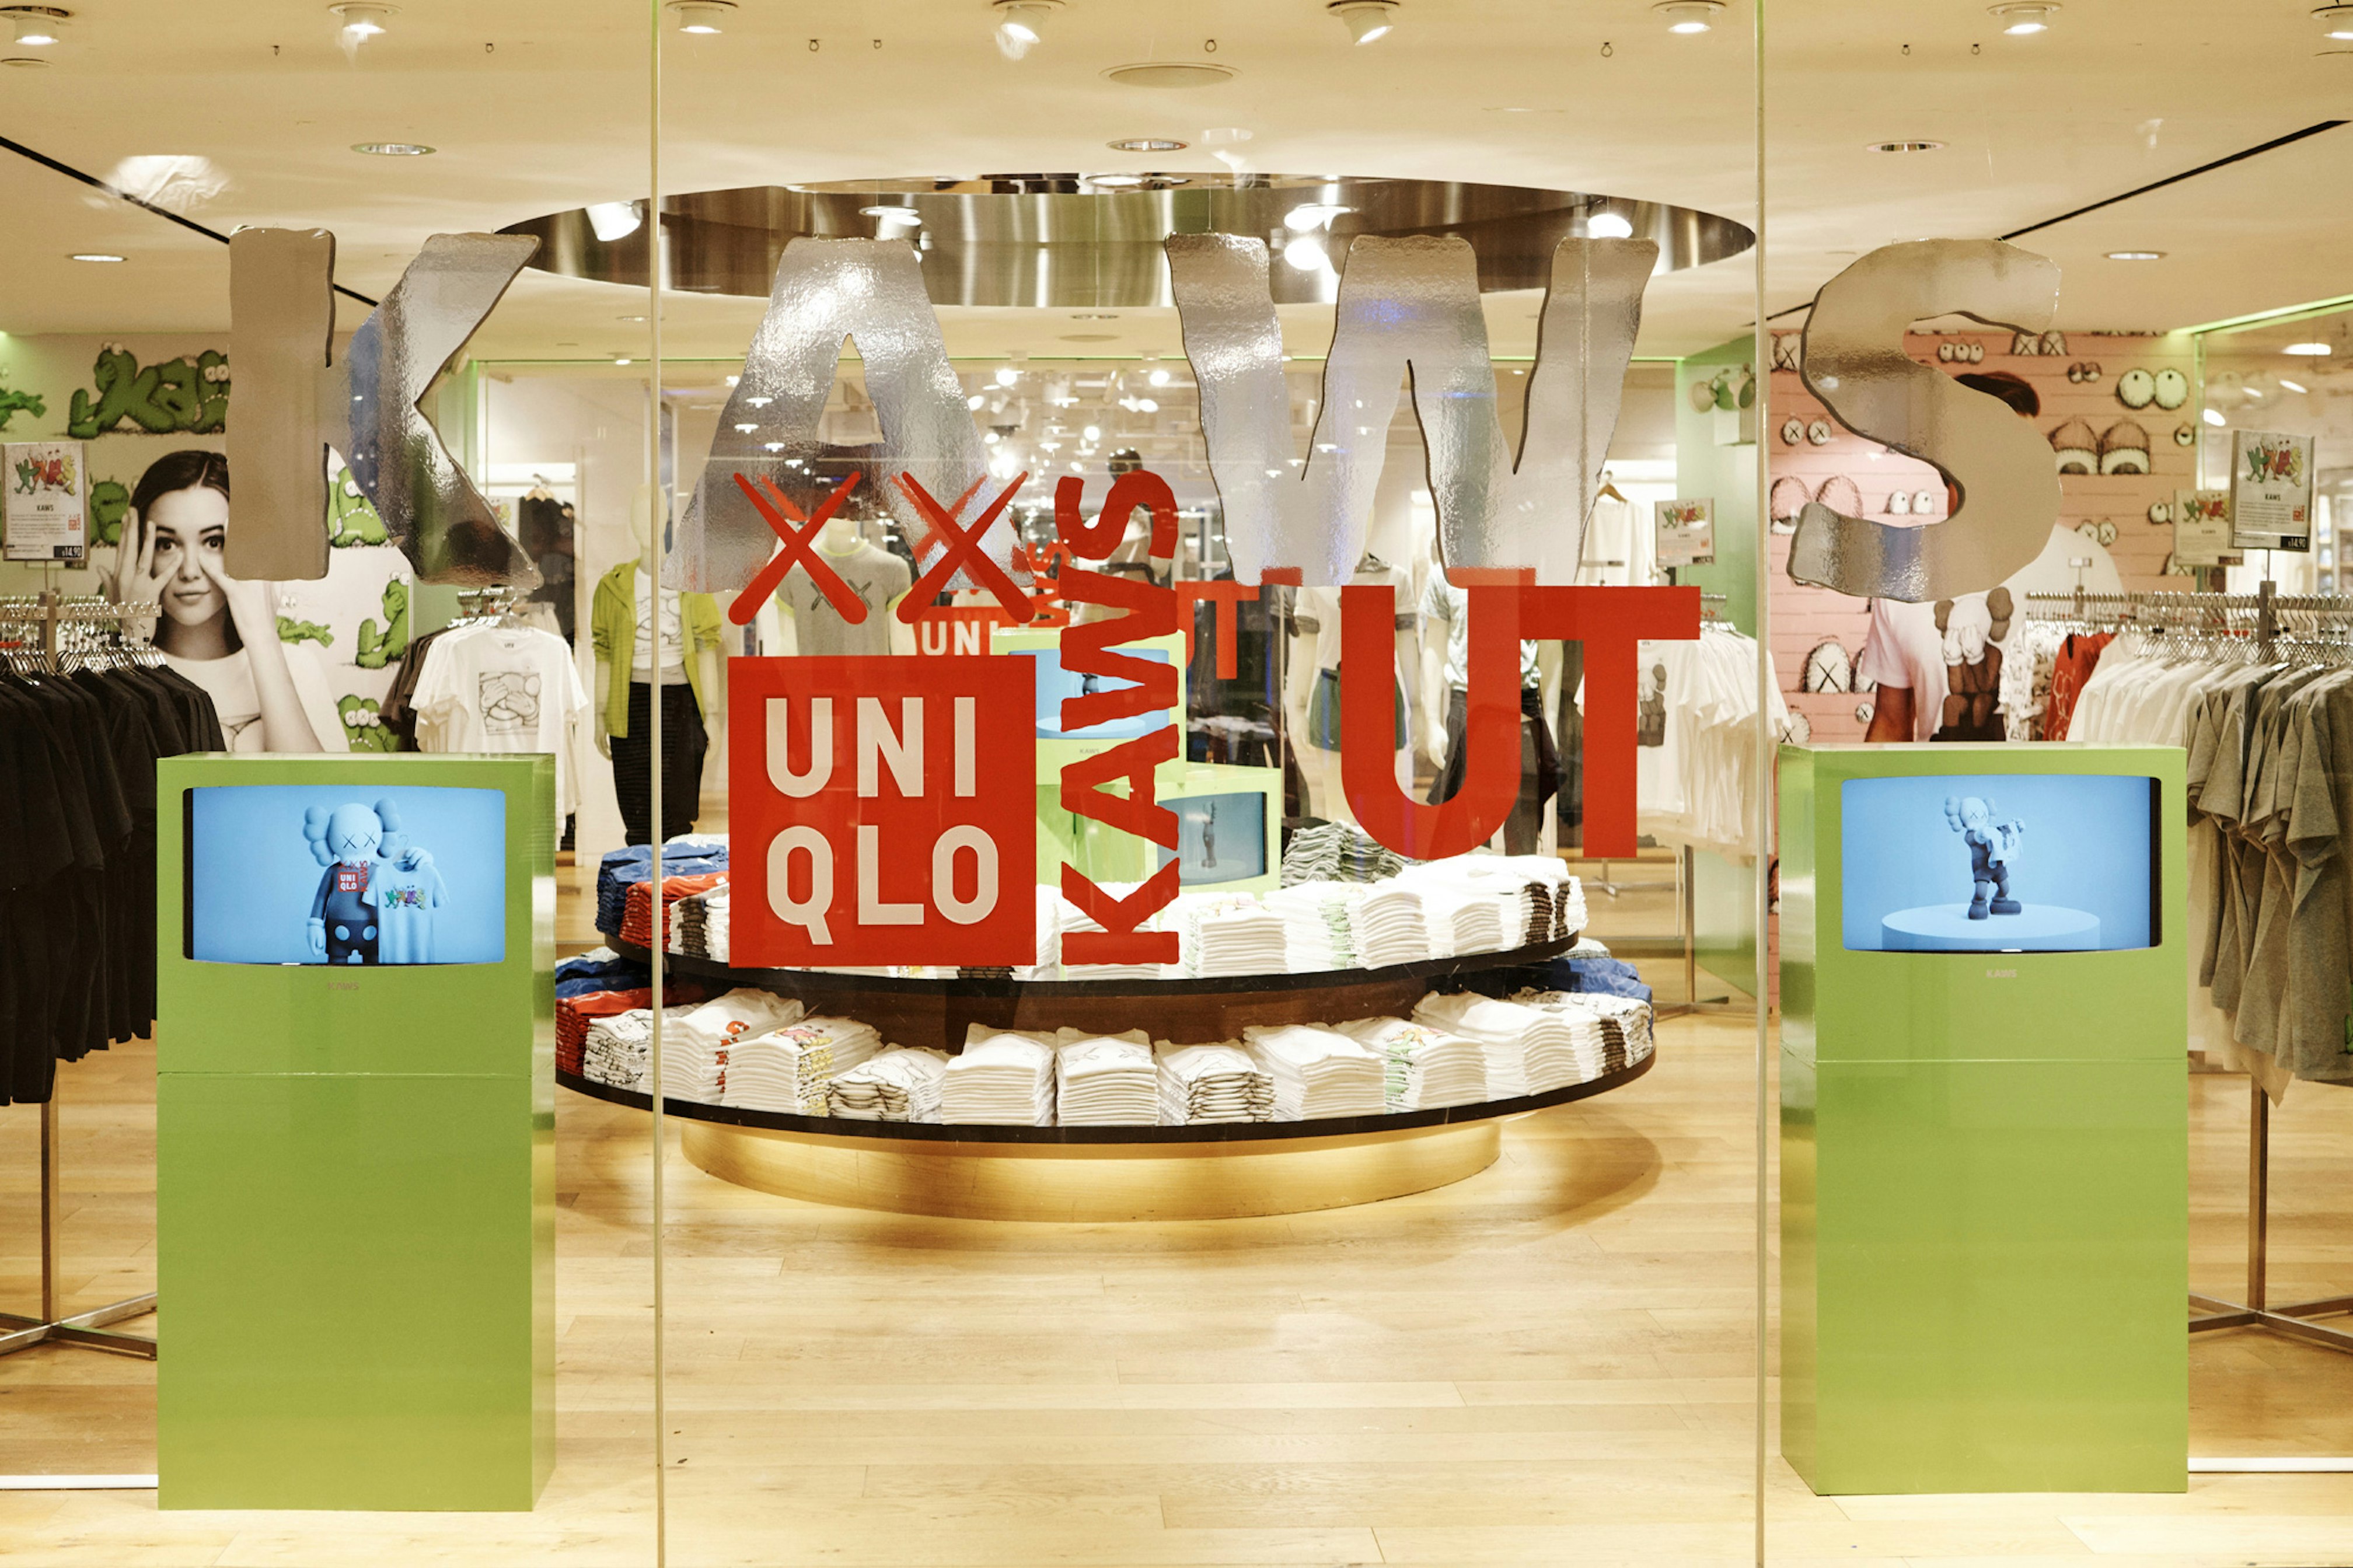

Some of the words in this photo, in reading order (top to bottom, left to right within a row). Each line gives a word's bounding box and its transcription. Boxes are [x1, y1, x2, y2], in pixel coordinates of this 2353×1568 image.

[225, 226, 2062, 602] KAWS
[765, 697, 977, 798] UNI
[1055, 470, 1180, 966] KAWS
[1341, 585, 1701, 859] UT
[340, 882, 357, 890] QLO
[766, 825, 1000, 945] QLO
